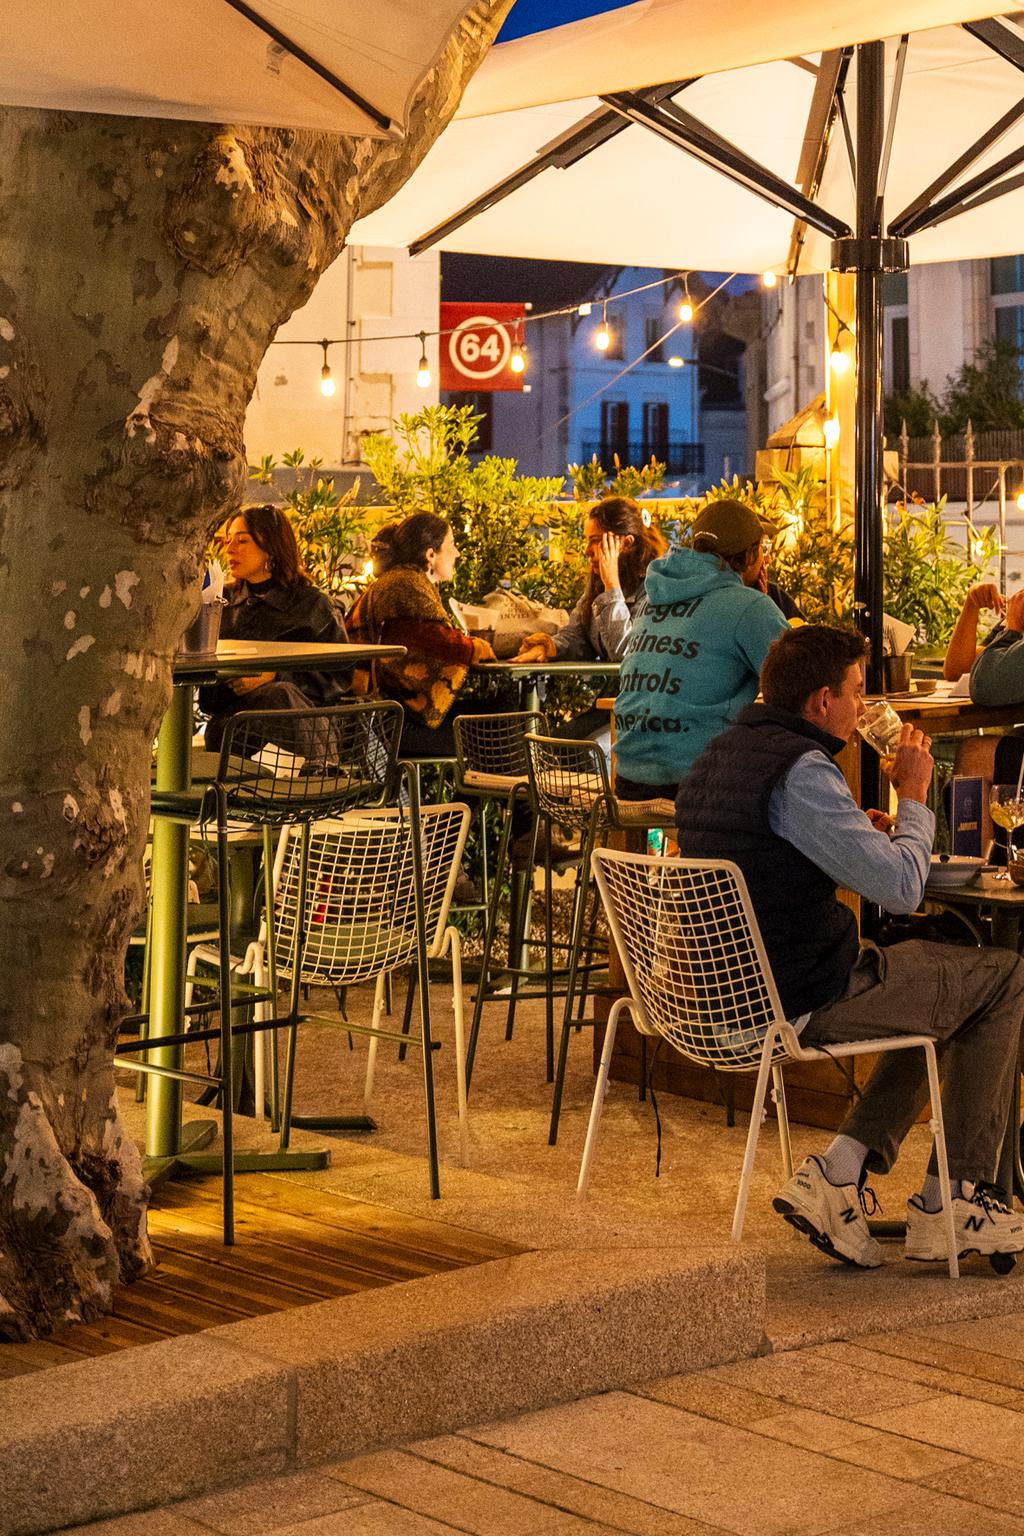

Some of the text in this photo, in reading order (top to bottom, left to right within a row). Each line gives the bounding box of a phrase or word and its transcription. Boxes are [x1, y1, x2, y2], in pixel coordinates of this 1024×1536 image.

[460, 332, 501, 363] 64
[620, 667, 682, 696] ntrols
[840, 1207, 857, 1224] N
[964, 1215, 985, 1232] N
